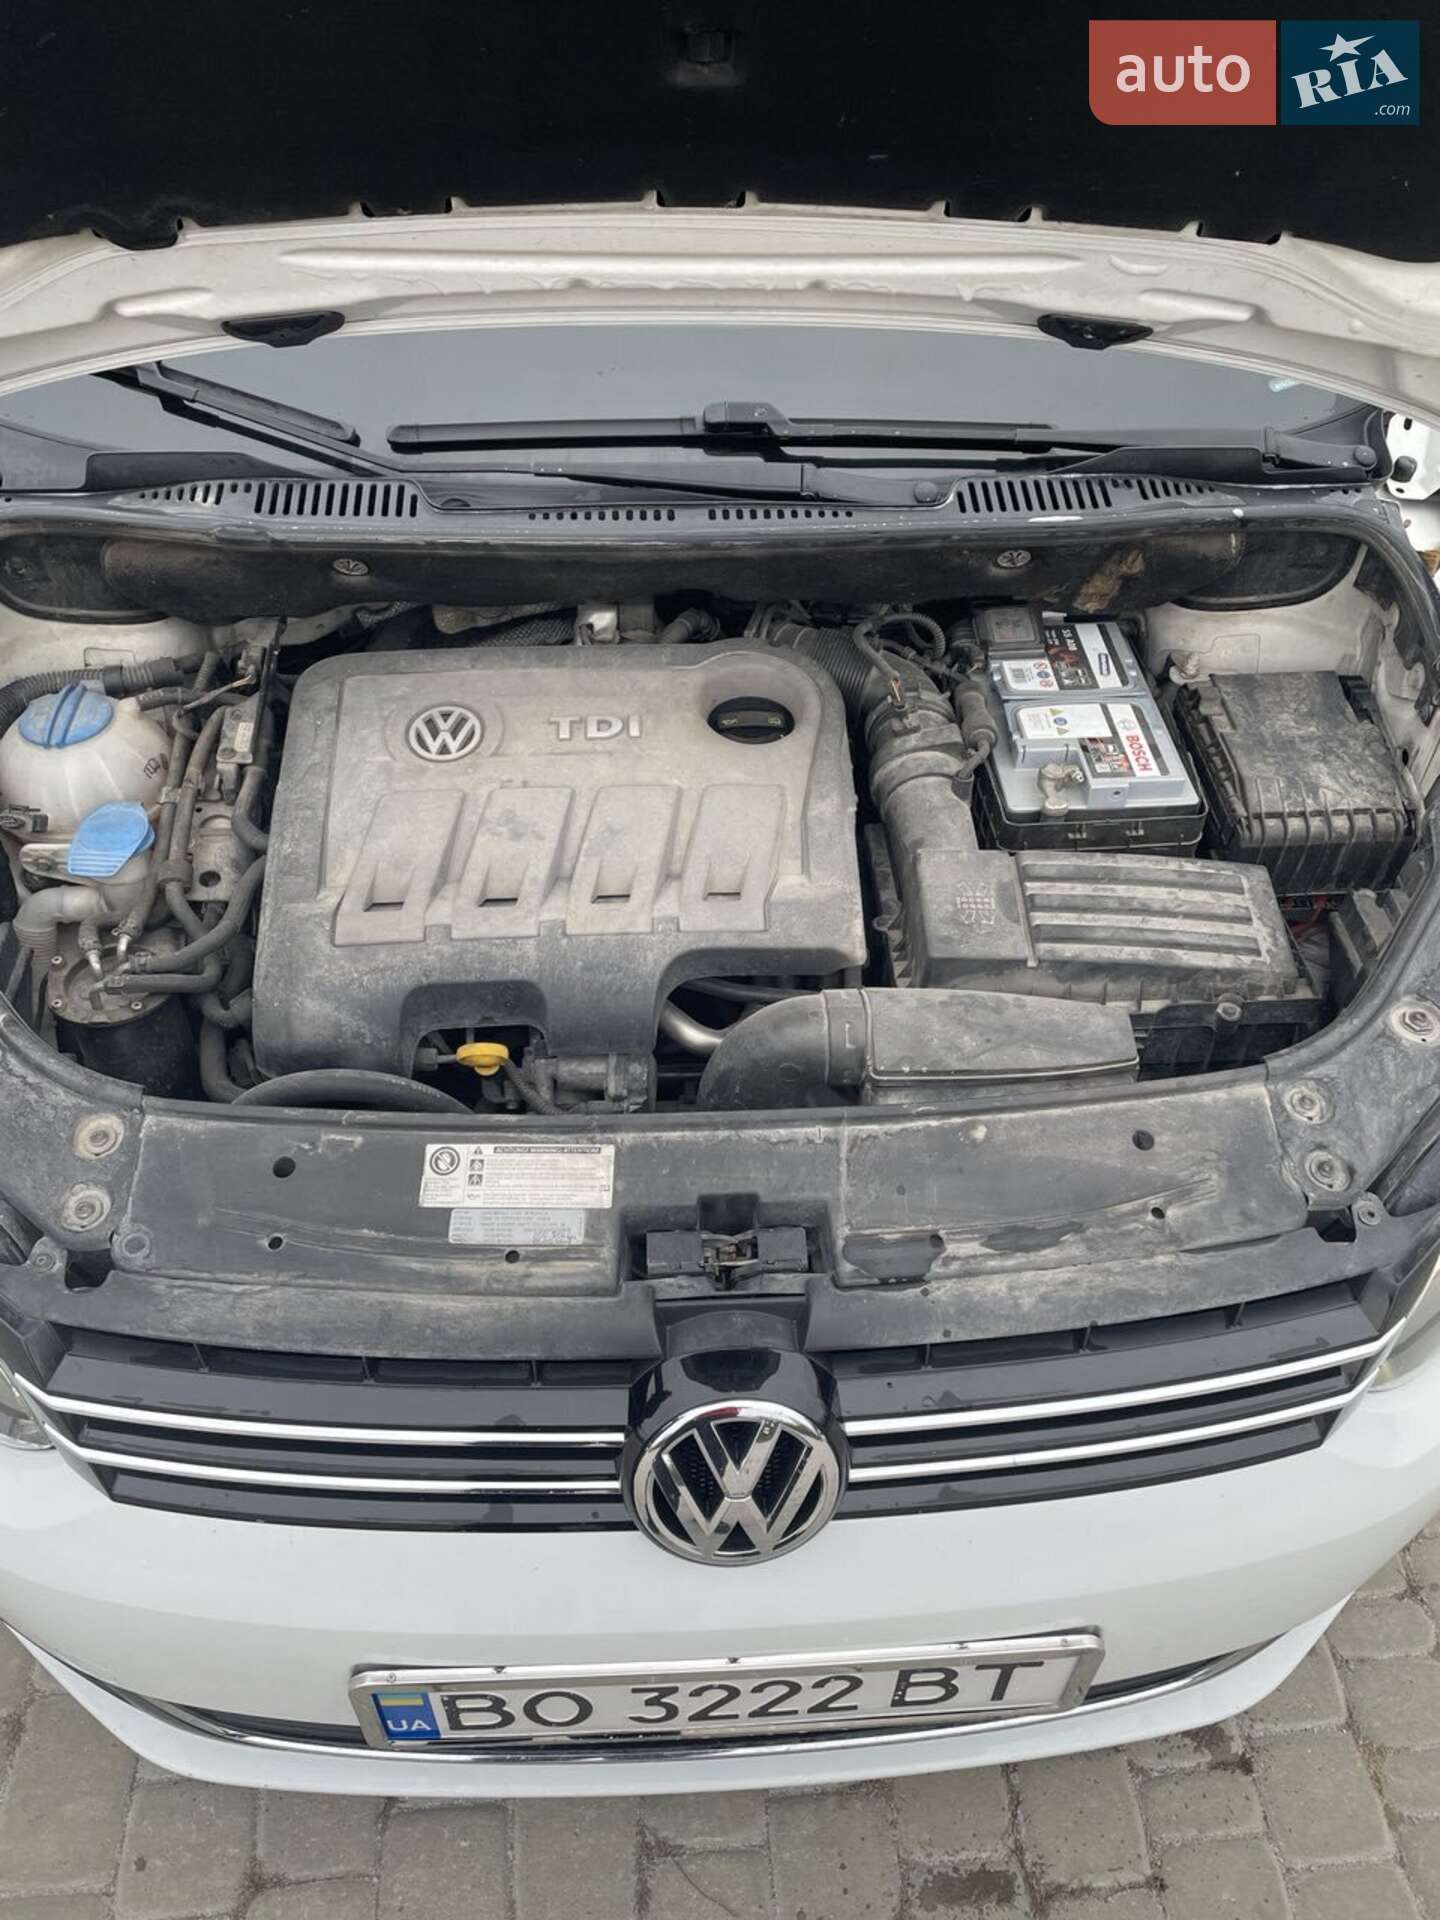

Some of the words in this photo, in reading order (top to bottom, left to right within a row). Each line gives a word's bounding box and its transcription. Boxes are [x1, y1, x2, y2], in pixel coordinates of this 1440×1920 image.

[549, 715, 643, 741] TDI
[1125, 735, 1153, 772] BOSCH
[444, 1690, 594, 1732] BO
[630, 1674, 863, 1724] 3222
[890, 1660, 1044, 1709] BT
[388, 1715, 432, 1734] UA
